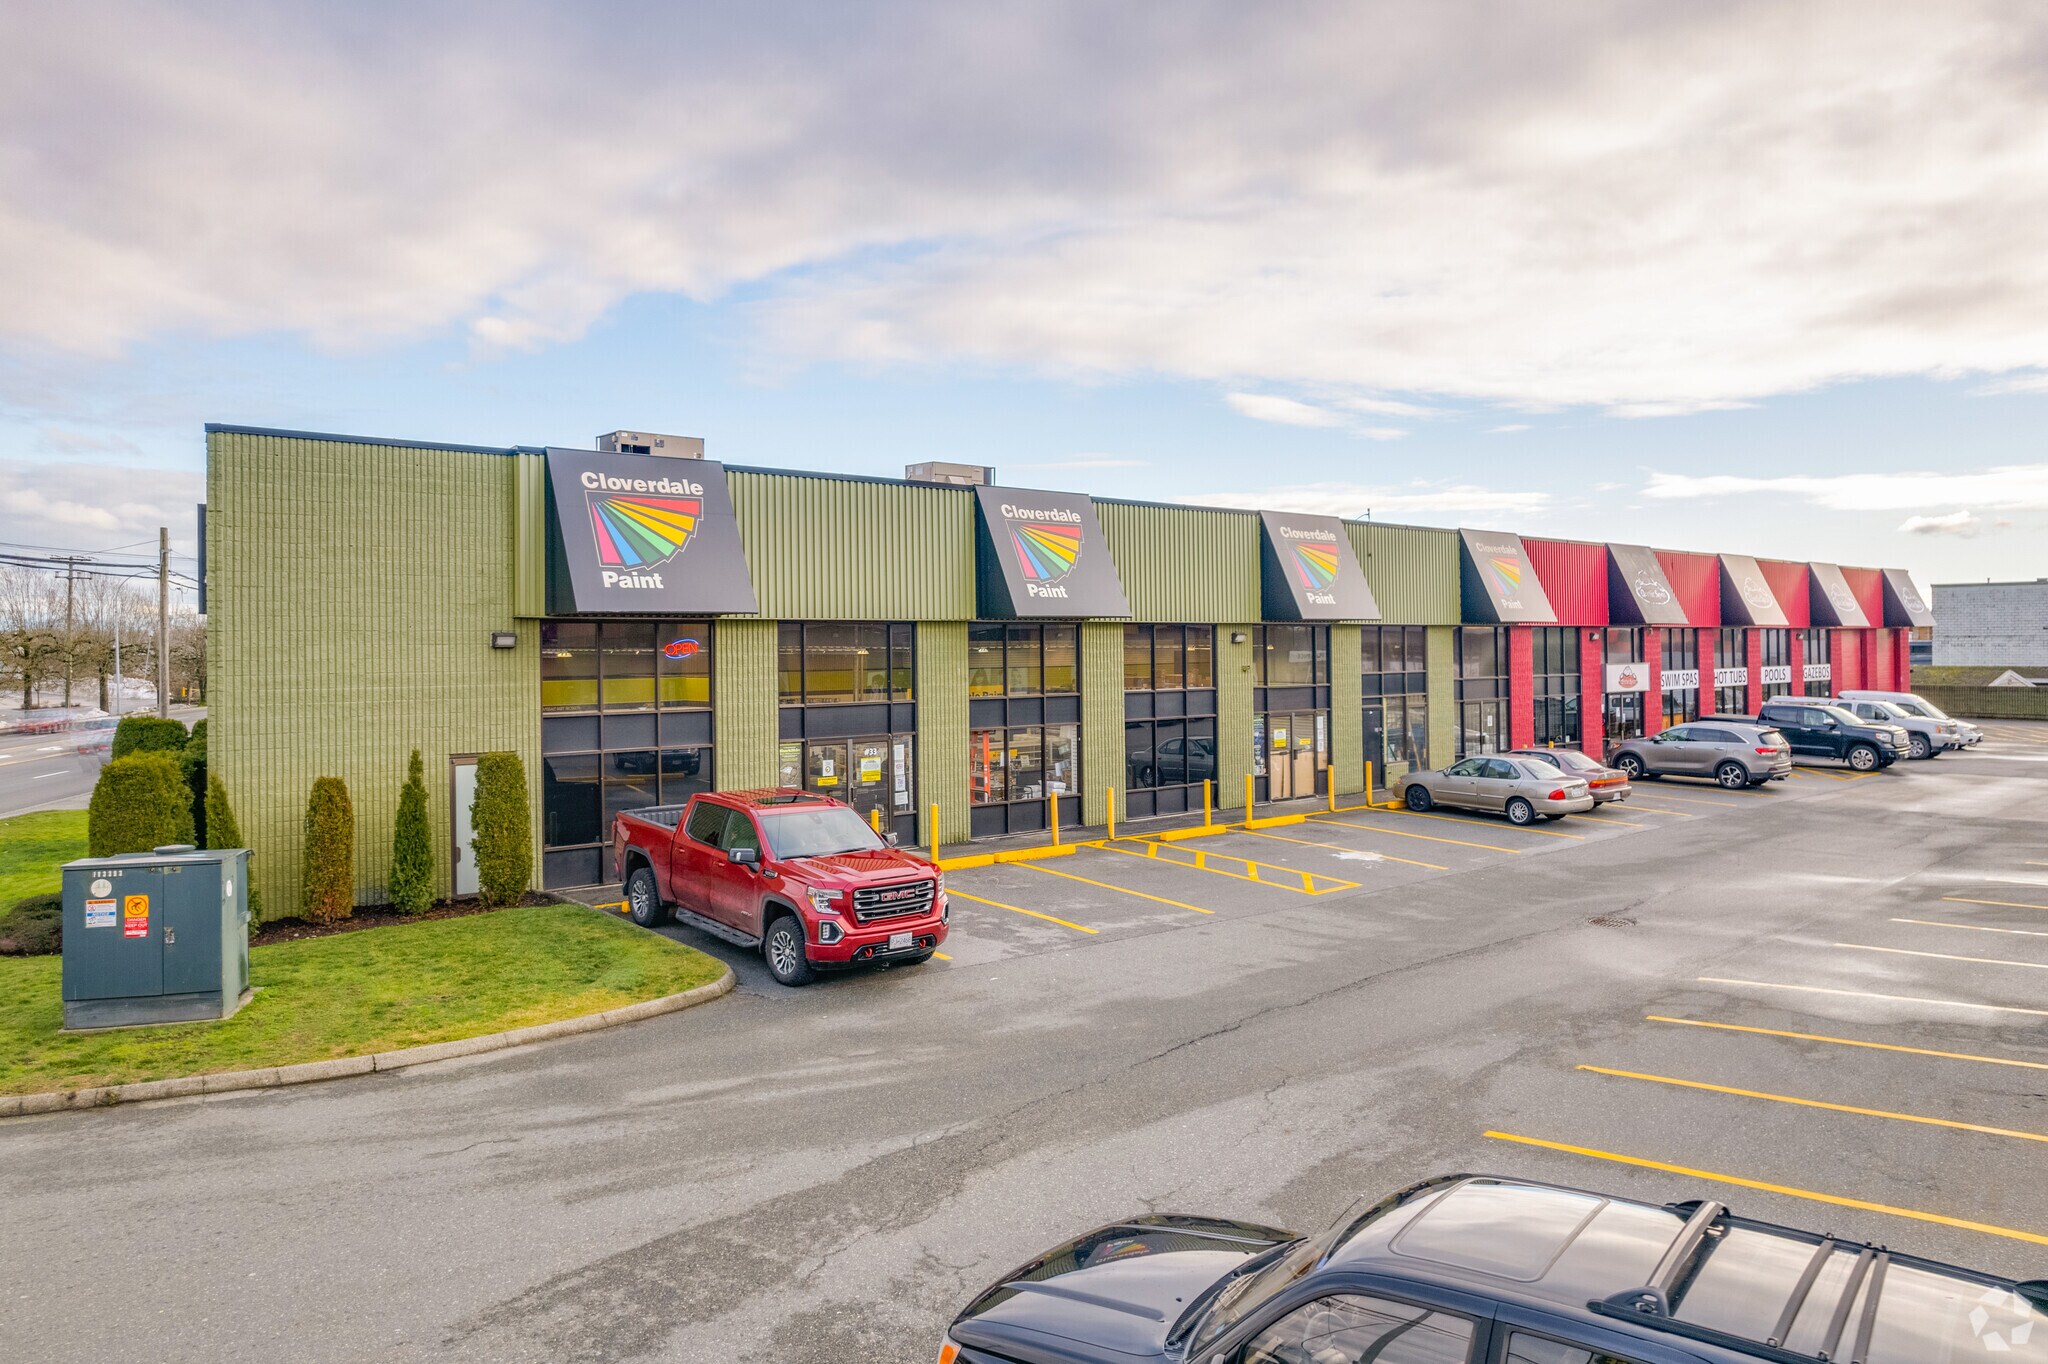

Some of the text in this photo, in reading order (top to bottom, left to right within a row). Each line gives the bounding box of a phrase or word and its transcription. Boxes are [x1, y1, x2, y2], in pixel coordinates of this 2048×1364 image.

[581, 471, 704, 496] Cloverdale
[1000, 503, 1082, 523] Cloverdale
[1279, 526, 1337, 542] Cloverdale
[1475, 542, 1518, 556] Cloverdale
[601, 570, 664, 589] Paint
[1026, 583, 1069, 599] Paint
[1305, 592, 1336, 605] Paint
[1500, 598, 1523, 609] Paint
[664, 642, 699, 656] OPEN
[1714, 670, 1746, 684] HOT TUBS
[1764, 668, 1786, 681] POOLS
[1803, 666, 1830, 679] GAZEBOS
[1661, 672, 1698, 688] SWIM SPAS
[881, 889, 915, 901] GMC
